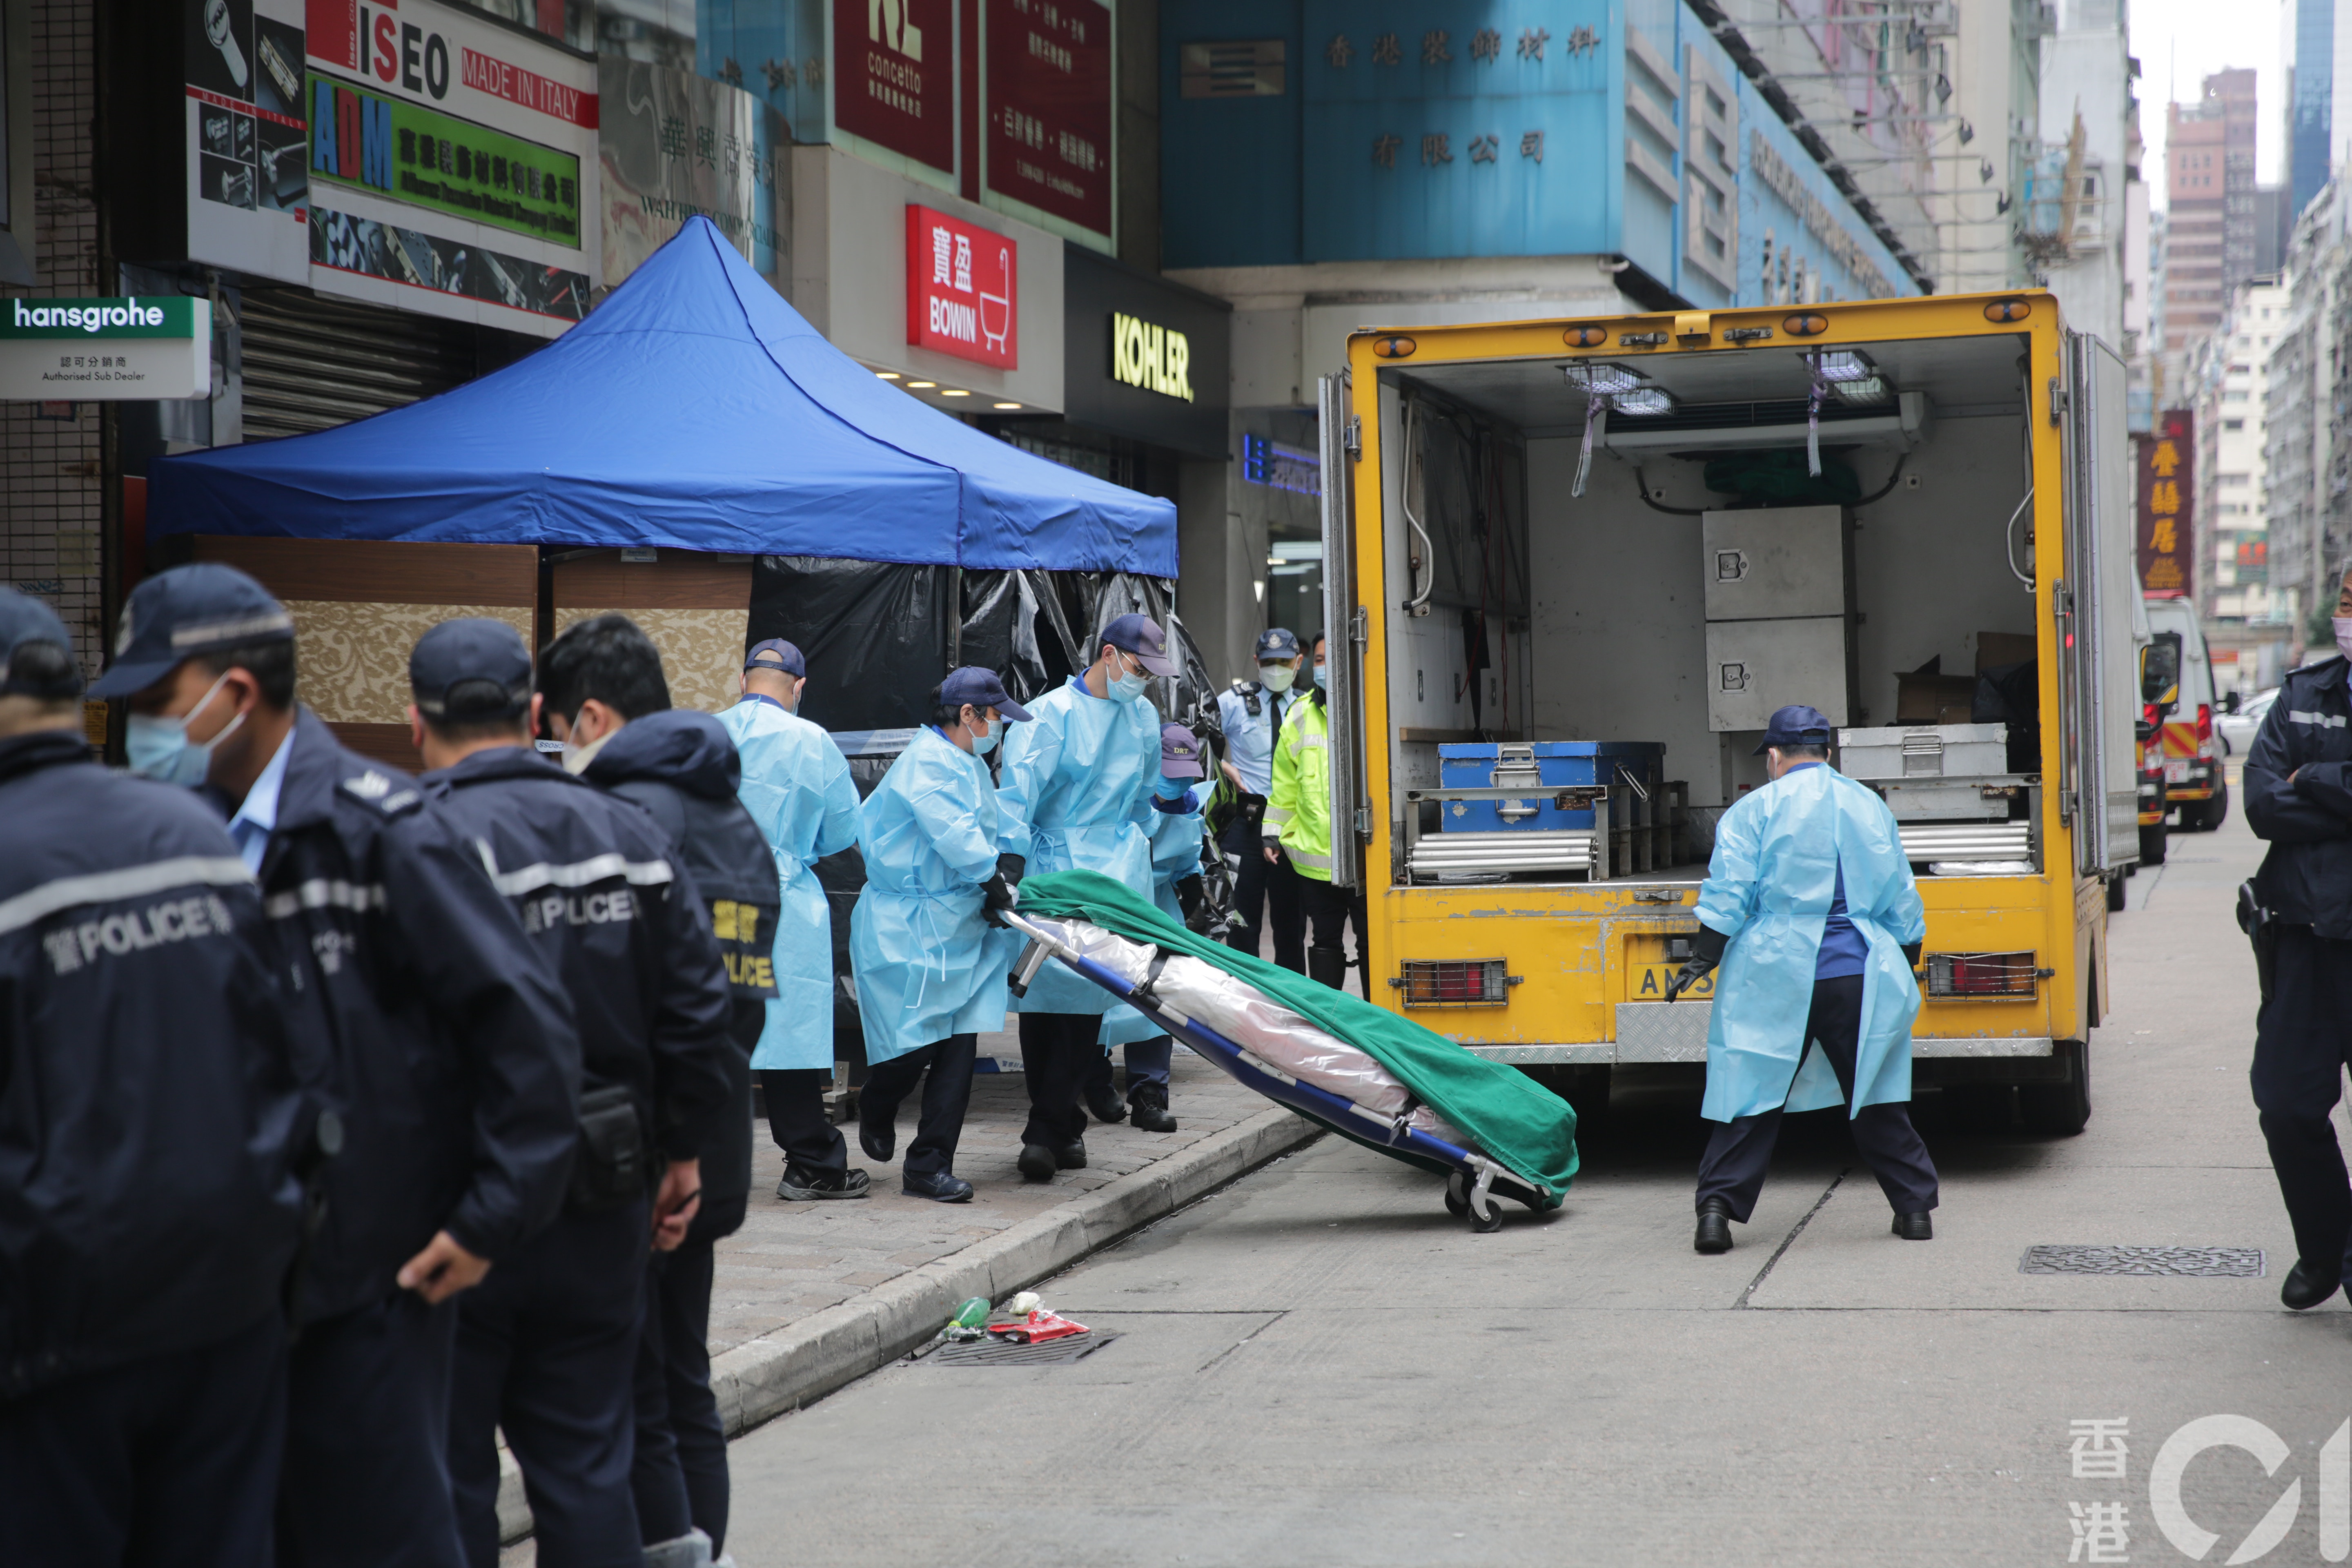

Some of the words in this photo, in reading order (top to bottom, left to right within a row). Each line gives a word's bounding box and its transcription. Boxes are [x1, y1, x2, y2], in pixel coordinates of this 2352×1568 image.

[361, 6, 449, 100] ISEO
[1327, 23, 1600, 68] 香港裝飾材料
[461, 49, 510, 98] MADE
[517, 70, 534, 106] IN
[540, 78, 579, 120] ITALY
[868, 51, 922, 95] concetto
[203, 91, 235, 109] MADE
[245, 103, 257, 116] IN
[266, 108, 303, 129] ITALY
[313, 80, 393, 191] ADM
[1372, 130, 1545, 168] 有限公司
[640, 196, 675, 221] WAH
[932, 226, 973, 293] 寶盈
[15, 298, 163, 332] hansgrohe
[929, 295, 976, 344] BOWIN
[42, 372, 91, 381] Authorised
[94, 372, 111, 381] Sub
[114, 372, 145, 381] Dealer
[60, 356, 126, 368] 認可分銷商
[1114, 311, 1192, 400] KOHLER
[78, 895, 212, 964] POLICE
